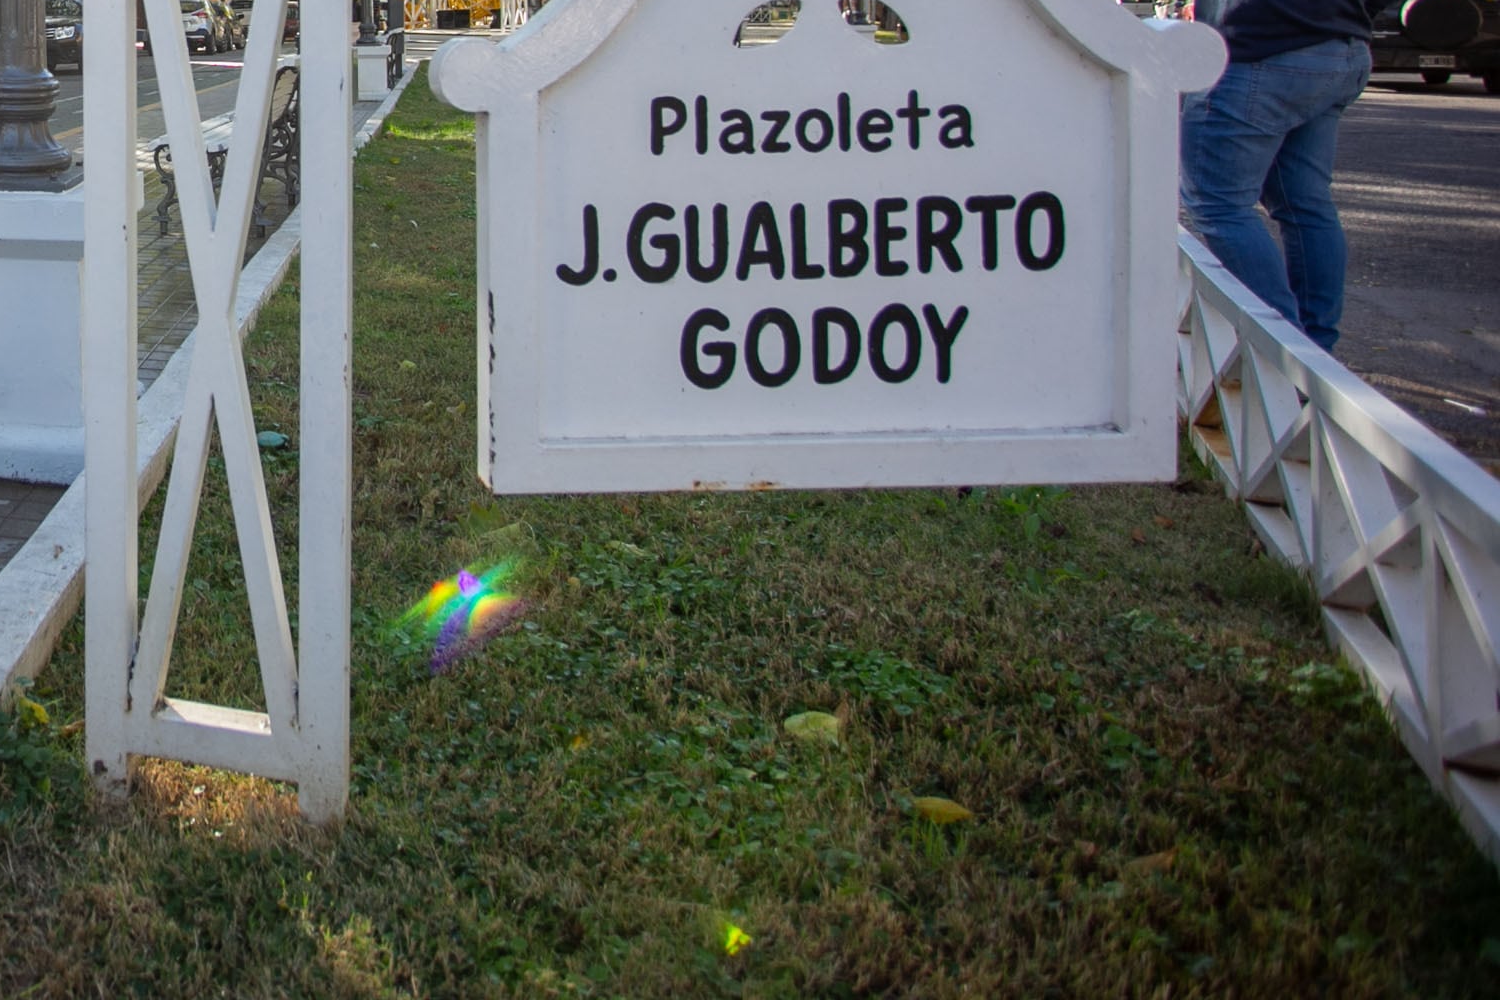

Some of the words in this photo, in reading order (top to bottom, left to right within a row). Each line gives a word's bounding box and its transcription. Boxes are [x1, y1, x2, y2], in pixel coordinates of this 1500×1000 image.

[650, 89, 975, 156] Plazoleta
[555, 190, 1066, 287] J.GUALBERTO
[680, 302, 970, 389] GODOY
